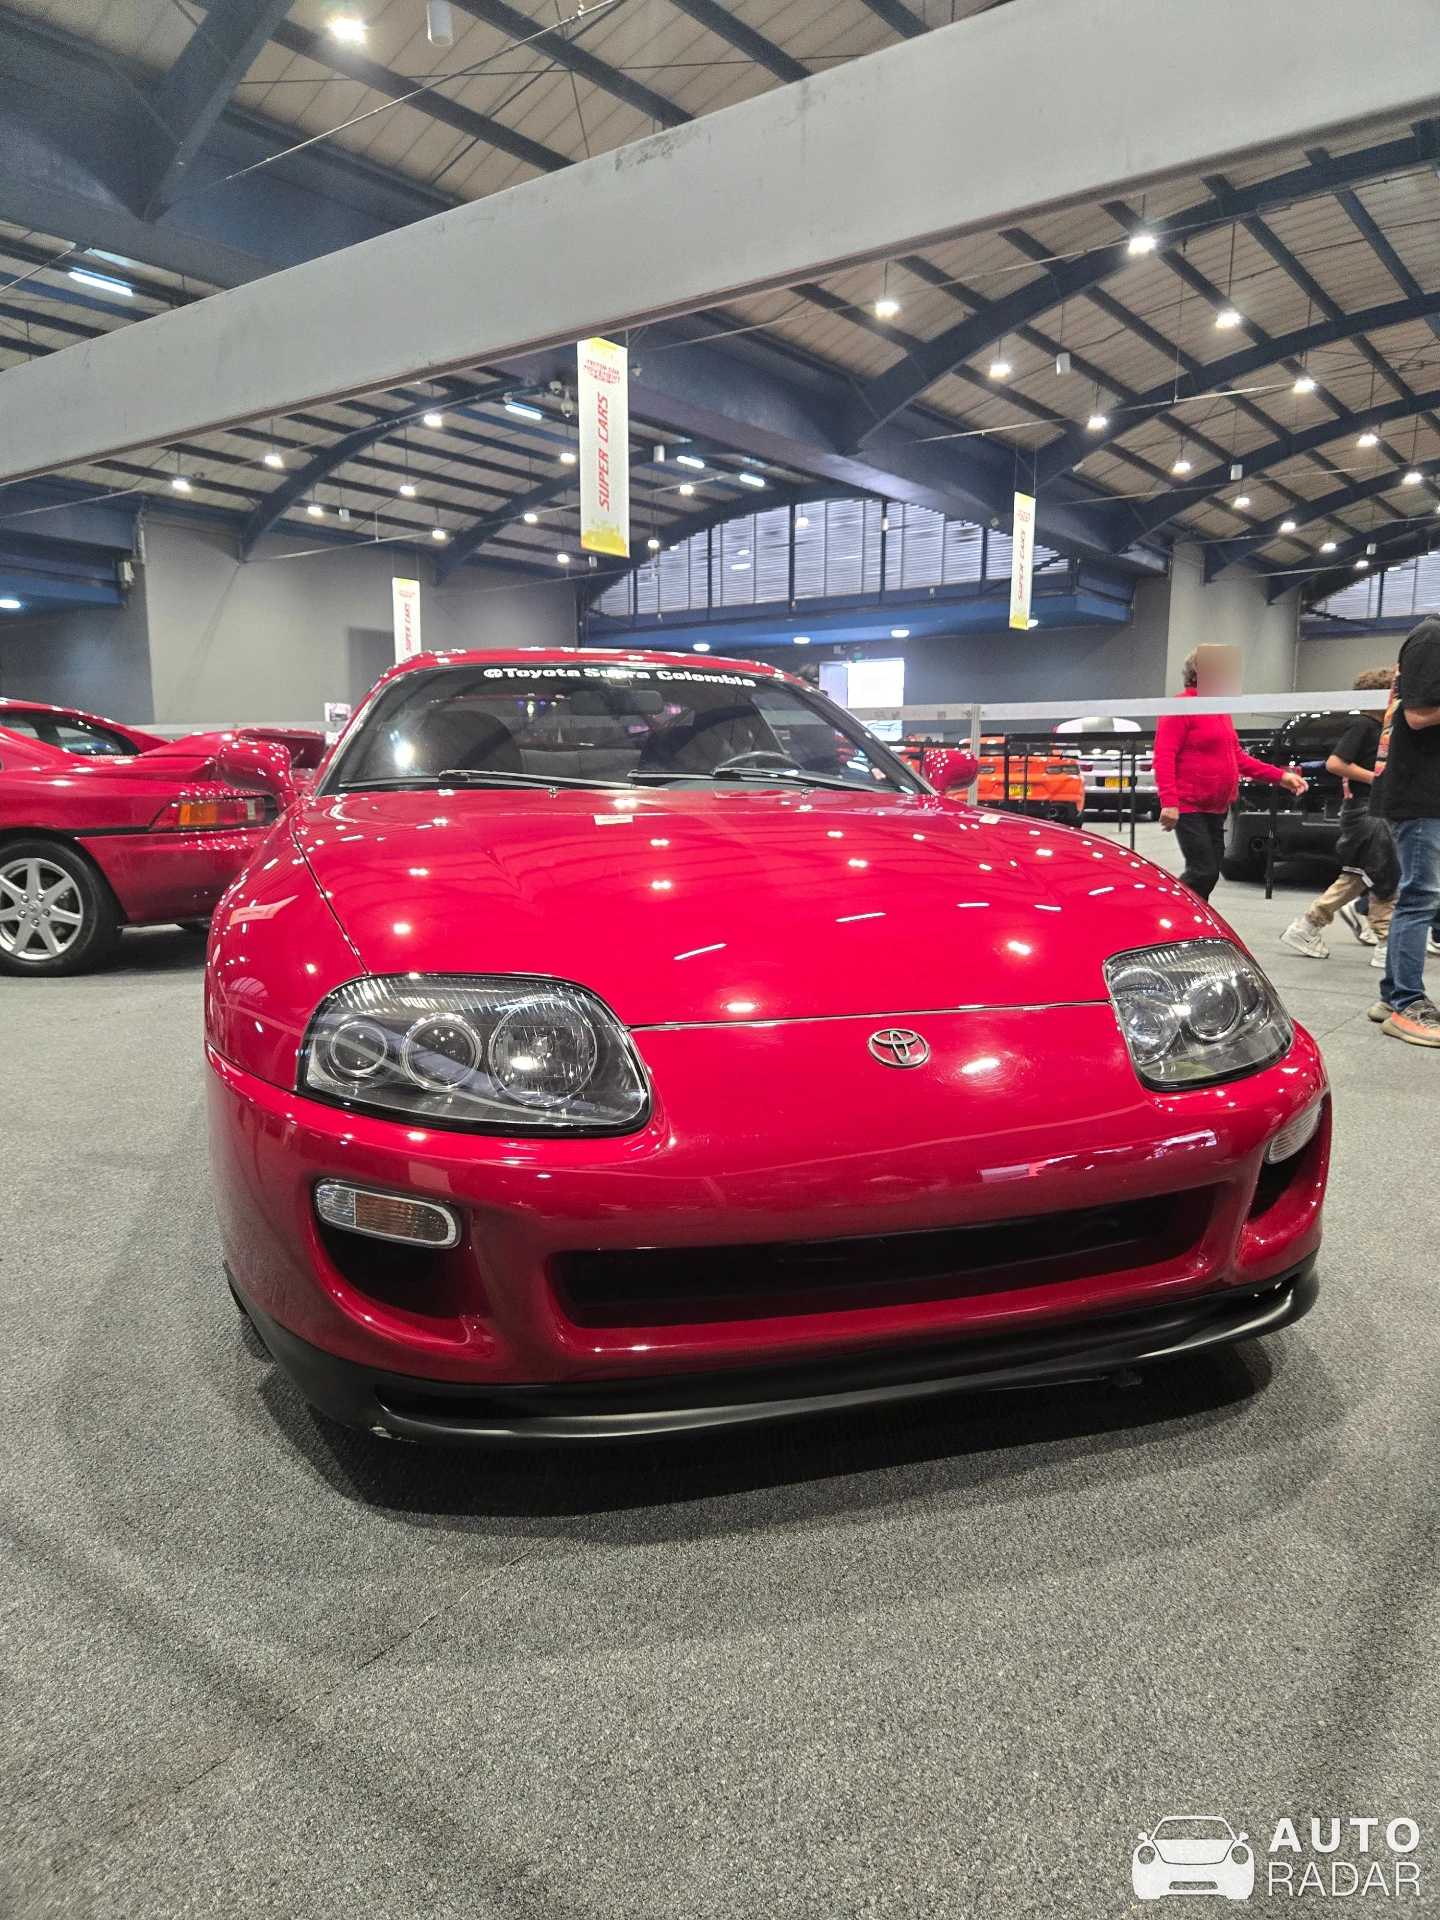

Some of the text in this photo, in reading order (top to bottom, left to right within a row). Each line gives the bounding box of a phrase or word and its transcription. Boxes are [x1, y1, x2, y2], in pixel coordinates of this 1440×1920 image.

[598, 392, 609, 444] CARS
[598, 448, 610, 512] SUPER
[483, 667, 757, 688] @Toyota Supra Colombia
